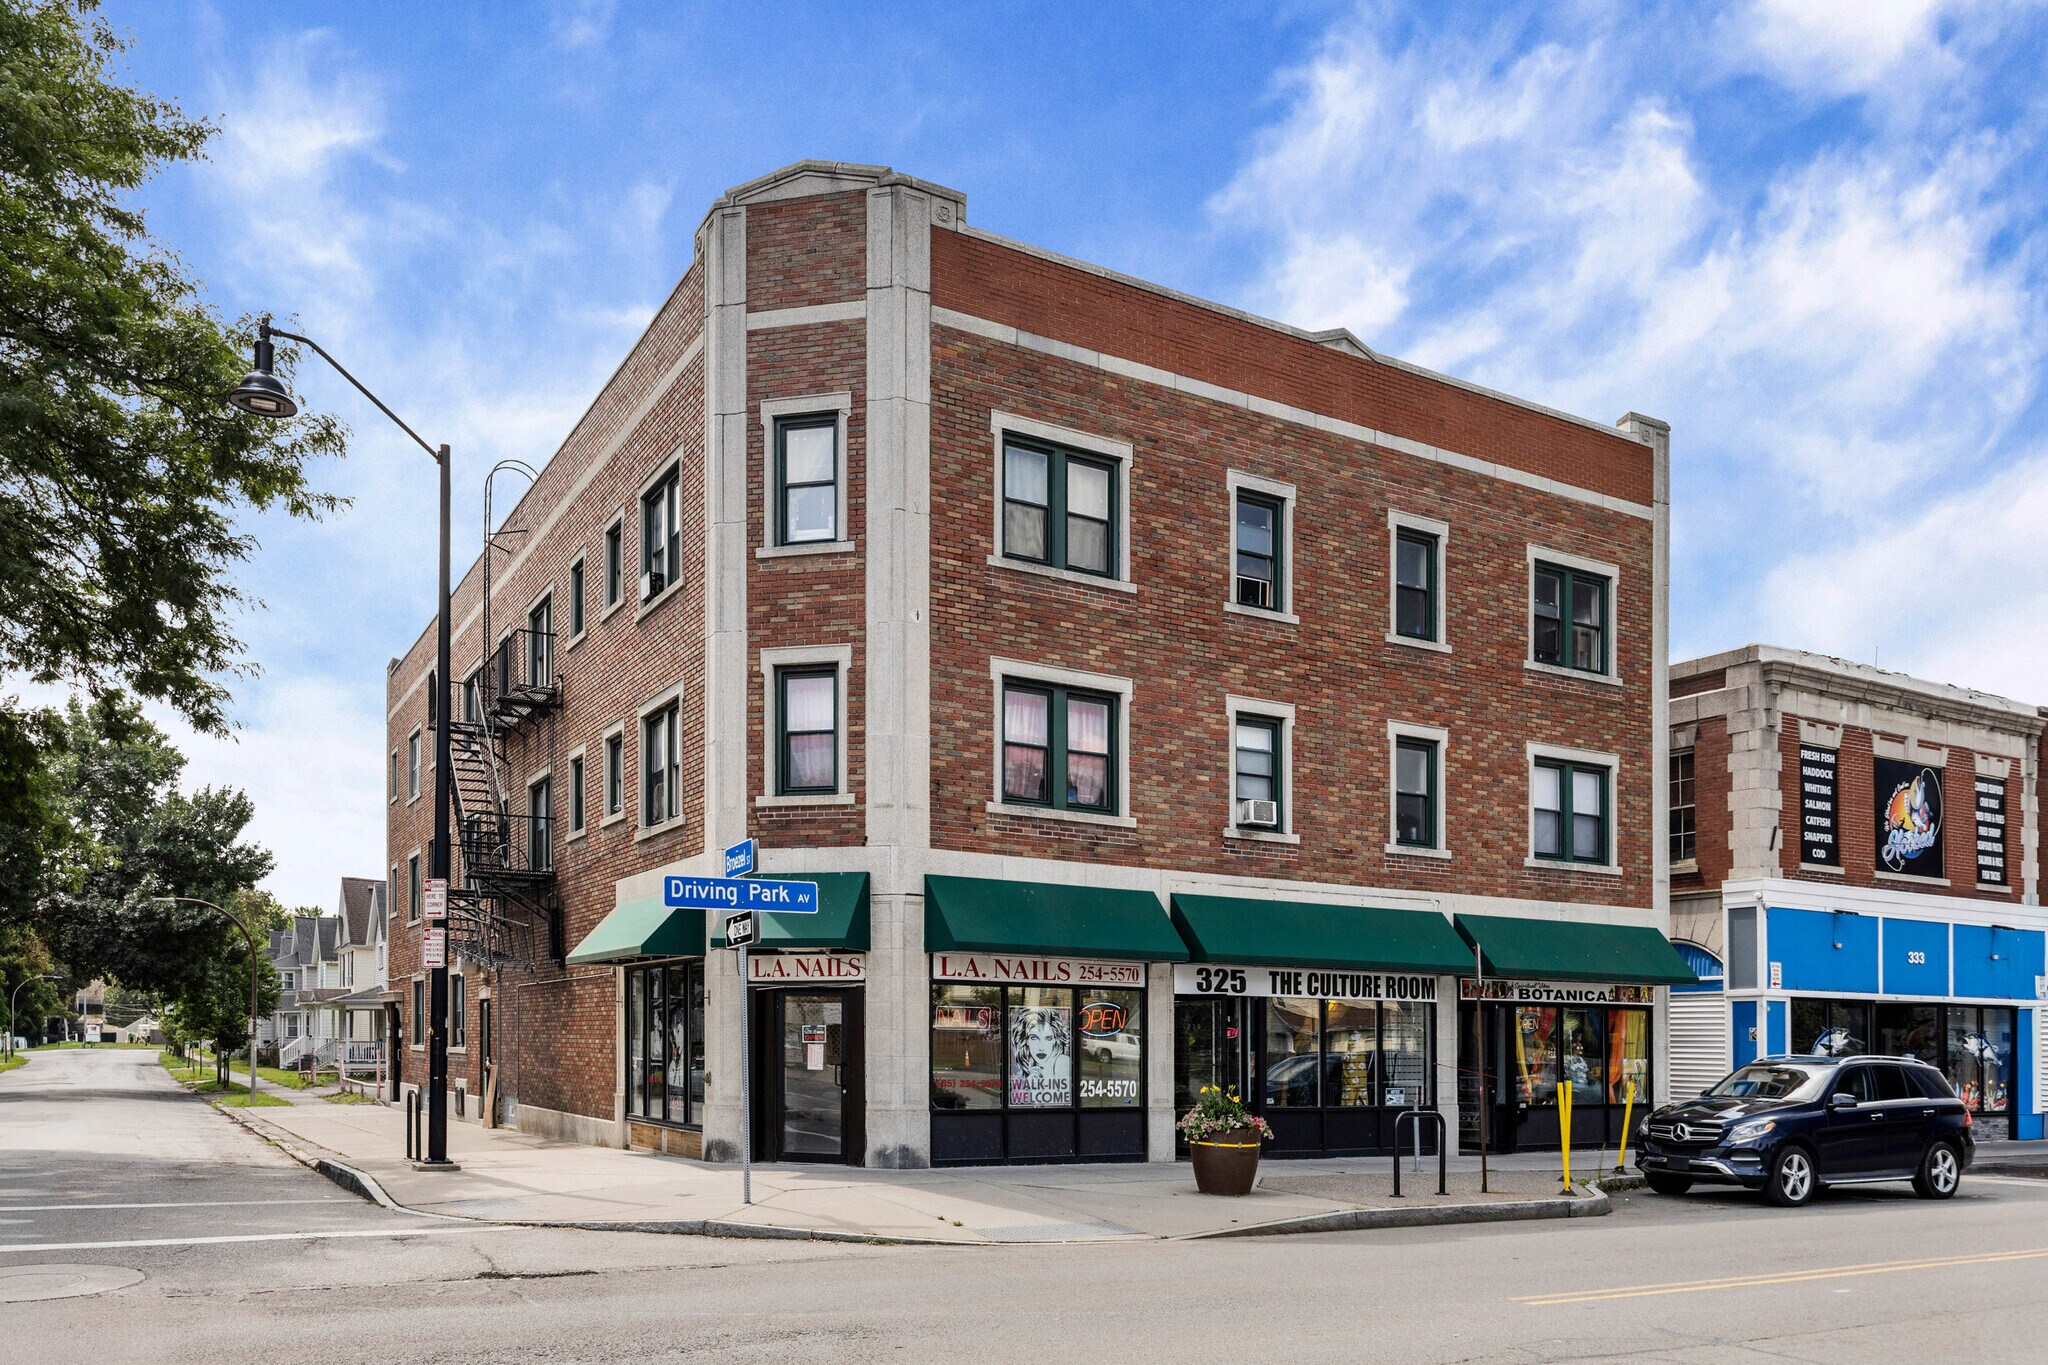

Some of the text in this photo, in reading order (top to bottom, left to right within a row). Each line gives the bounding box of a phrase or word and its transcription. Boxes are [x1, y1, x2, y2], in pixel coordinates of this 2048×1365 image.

[1801, 750, 1835, 763] FRESH FISH
[1803, 766, 1833, 779] HADDOCK
[1804, 782, 1831, 795] WHITING
[1805, 799, 1831, 811] SALMON
[1805, 816, 1830, 827] CATFISH
[1804, 832, 1833, 843] SNAPPER
[1812, 849, 1826, 858] COD
[671, 880, 810, 905] Driving Park AV
[734, 923, 742, 937] ONE
[1908, 952, 1925, 964] 333
[754, 958, 861, 977] L.A. NAILS
[940, 957, 1139, 982] L.A. NAILS 254-5570
[1197, 968, 1436, 999] 325 THE CULTURE ROOM
[1519, 989, 1608, 1002] BOTANICA
[937, 1009, 988, 1028] NAILS
[1079, 1009, 1127, 1030] OPEN
[1012, 1078, 1068, 1090] WALK-INS
[1080, 1080, 1137, 1098] 254-5570
[1012, 1092, 1070, 1103] WELCOME
